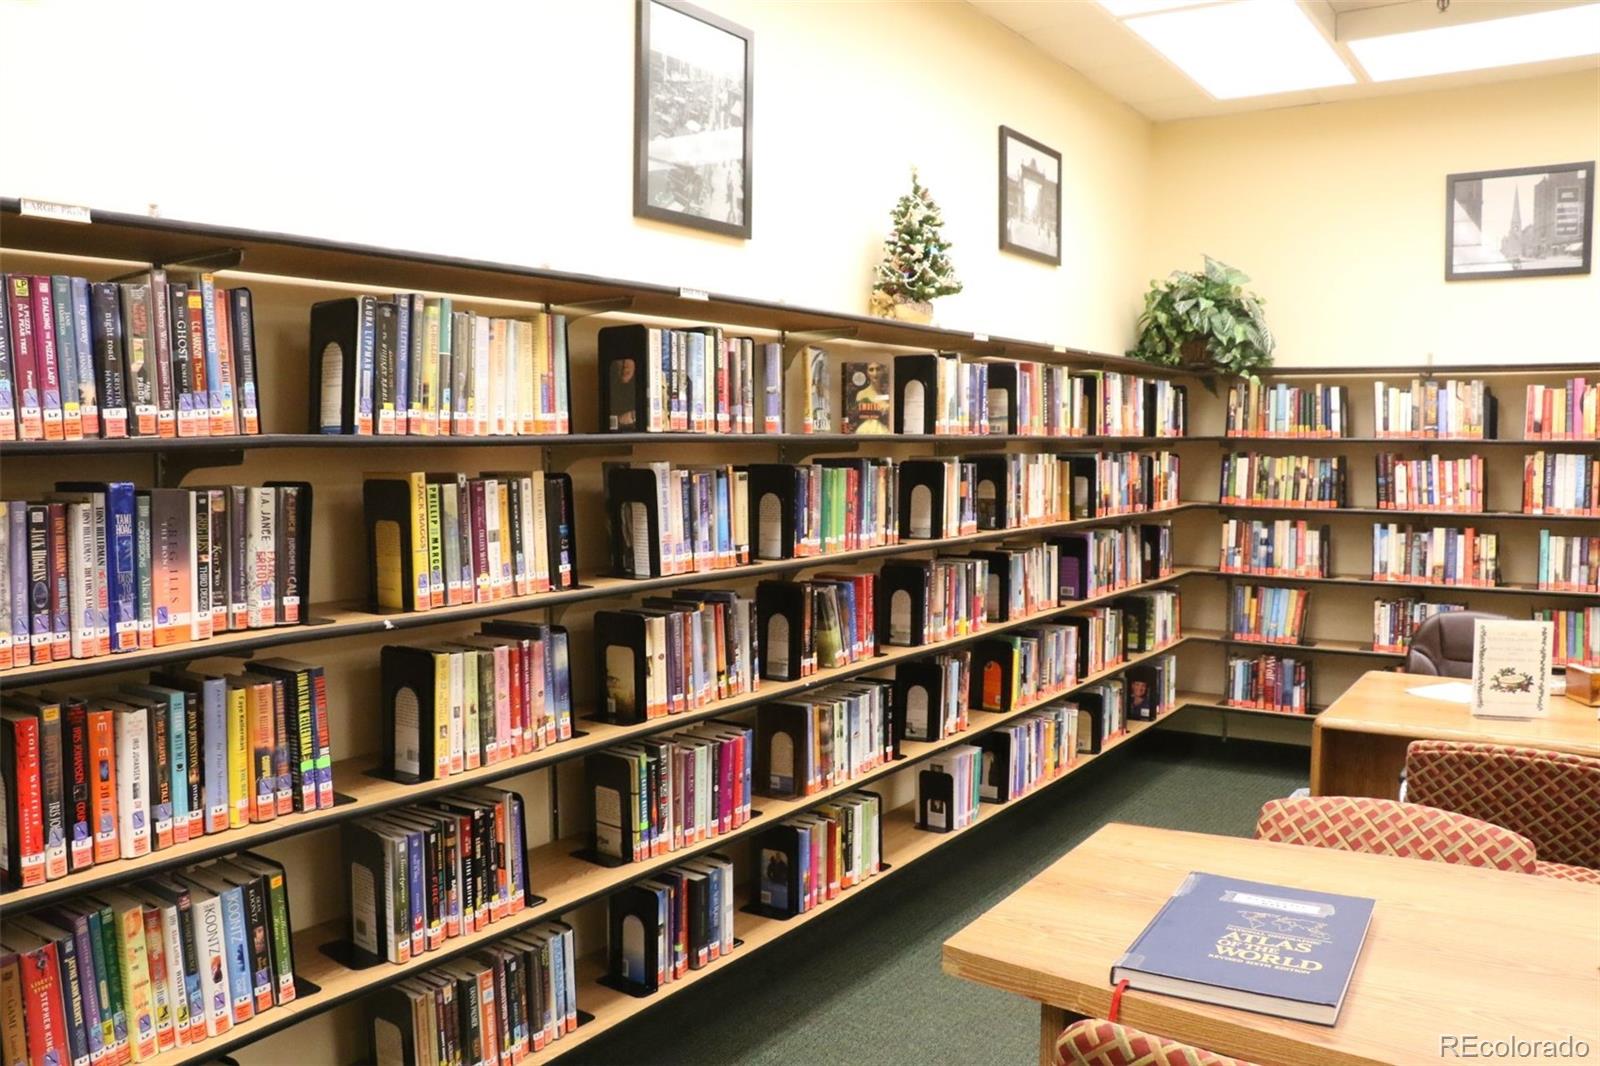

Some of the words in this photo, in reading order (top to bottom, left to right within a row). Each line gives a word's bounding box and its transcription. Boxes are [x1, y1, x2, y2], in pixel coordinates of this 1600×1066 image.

[41, 296, 53, 330] STALKING
[104, 313, 115, 337] night
[154, 291, 166, 329] Blackberry
[365, 299, 374, 327] LAURA
[45, 340, 55, 365] PUZZLE
[106, 340, 117, 361] road
[177, 320, 189, 362] GHOST
[364, 330, 374, 369] LIPPMAN
[48, 366, 56, 385] LADY
[104, 370, 114, 408] HANNAH
[112, 372, 122, 406] KRISTIN
[95, 507, 105, 524] TONY
[429, 488, 439, 526] PHILLIP
[31, 528, 47, 549] JACK
[260, 510, 271, 542] JANCE
[95, 526, 107, 567] HILLERMAN
[287, 537, 297, 575] JUDGMENT
[31, 549, 48, 583] HIGGINS
[199, 566, 208, 588] THIRD
[255, 551, 267, 588] ERROR
[141, 576, 152, 599] Alice
[287, 576, 298, 597] CAL
[296, 672, 310, 711] JONATHAN
[73, 727, 83, 743] IRIS
[132, 738, 141, 751] IRIS
[188, 730, 198, 768] JOHNSTON
[298, 711, 313, 756] KELLERMAN
[73, 743, 85, 784] JOHANSEN
[132, 751, 142, 782] JOHANSEN
[48, 800, 62, 817] IRIS
[227, 895, 243, 944] KOONTZ
[248, 888, 259, 925] KOONTZ
[203, 907, 220, 957] KOONTZ
[1216, 938, 1241, 948] OF
[1243, 942, 1280, 955] THE
[1219, 931, 1313, 953] ATLAS
[1215, 944, 1323, 972] WORLD
[39, 991, 50, 1030] STEPHEN
[45, 1032, 54, 1053] KING
